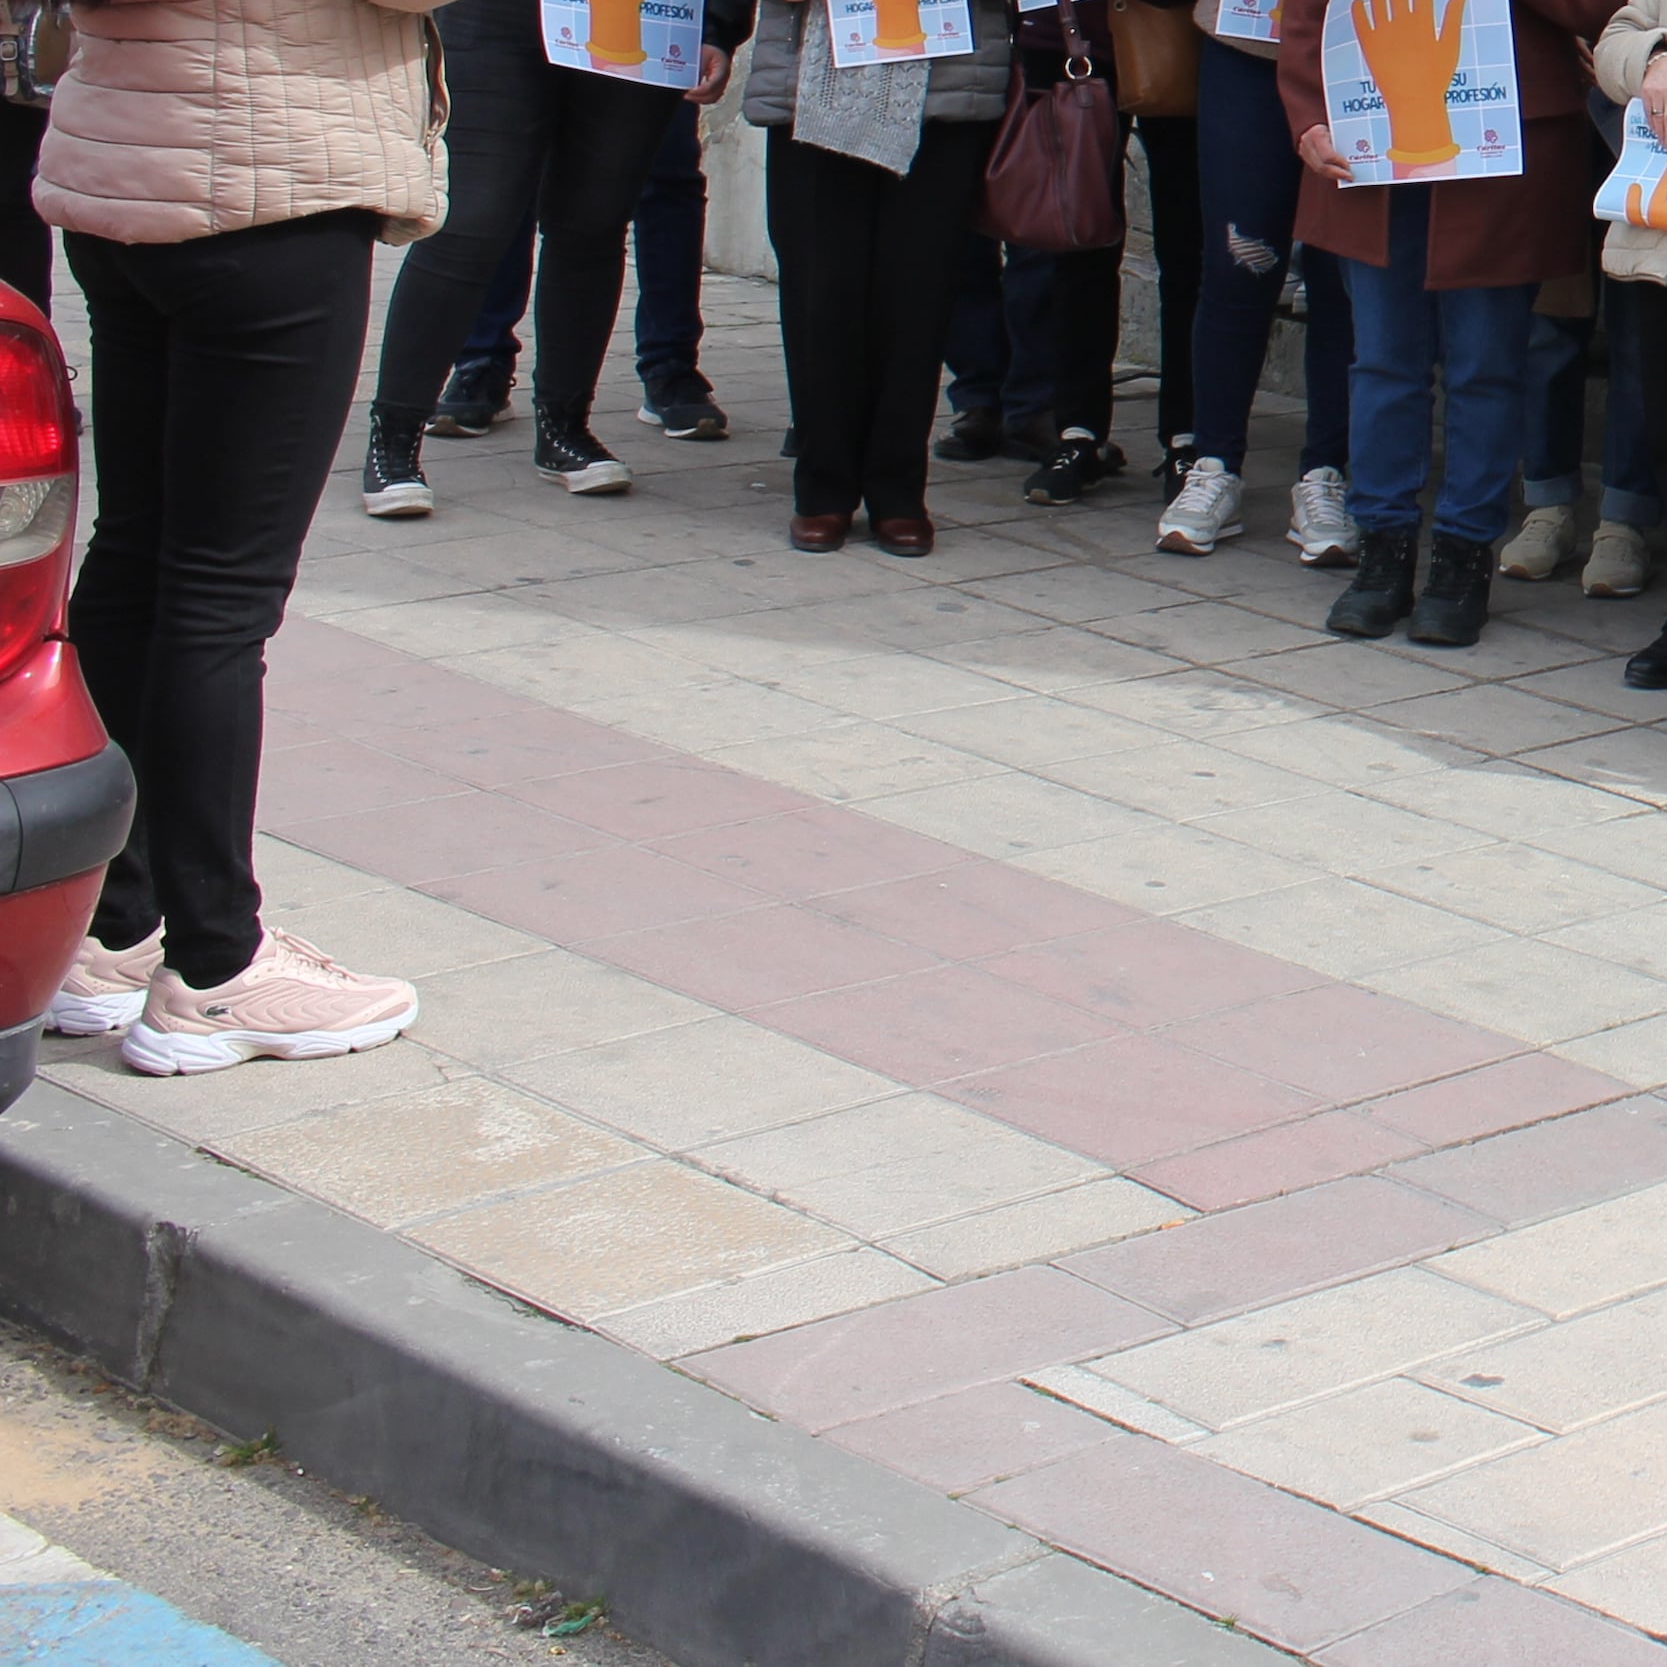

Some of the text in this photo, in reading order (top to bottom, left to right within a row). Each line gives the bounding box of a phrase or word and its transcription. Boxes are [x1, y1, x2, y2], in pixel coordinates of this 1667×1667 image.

[640, 2, 694, 21] PROFESIÓN
[1360, 80, 1376, 94] TU
[1451, 73, 1467, 87] SU
[1444, 82, 1507, 104] PROFESIÓN
[1343, 95, 1387, 113] HOGAR
